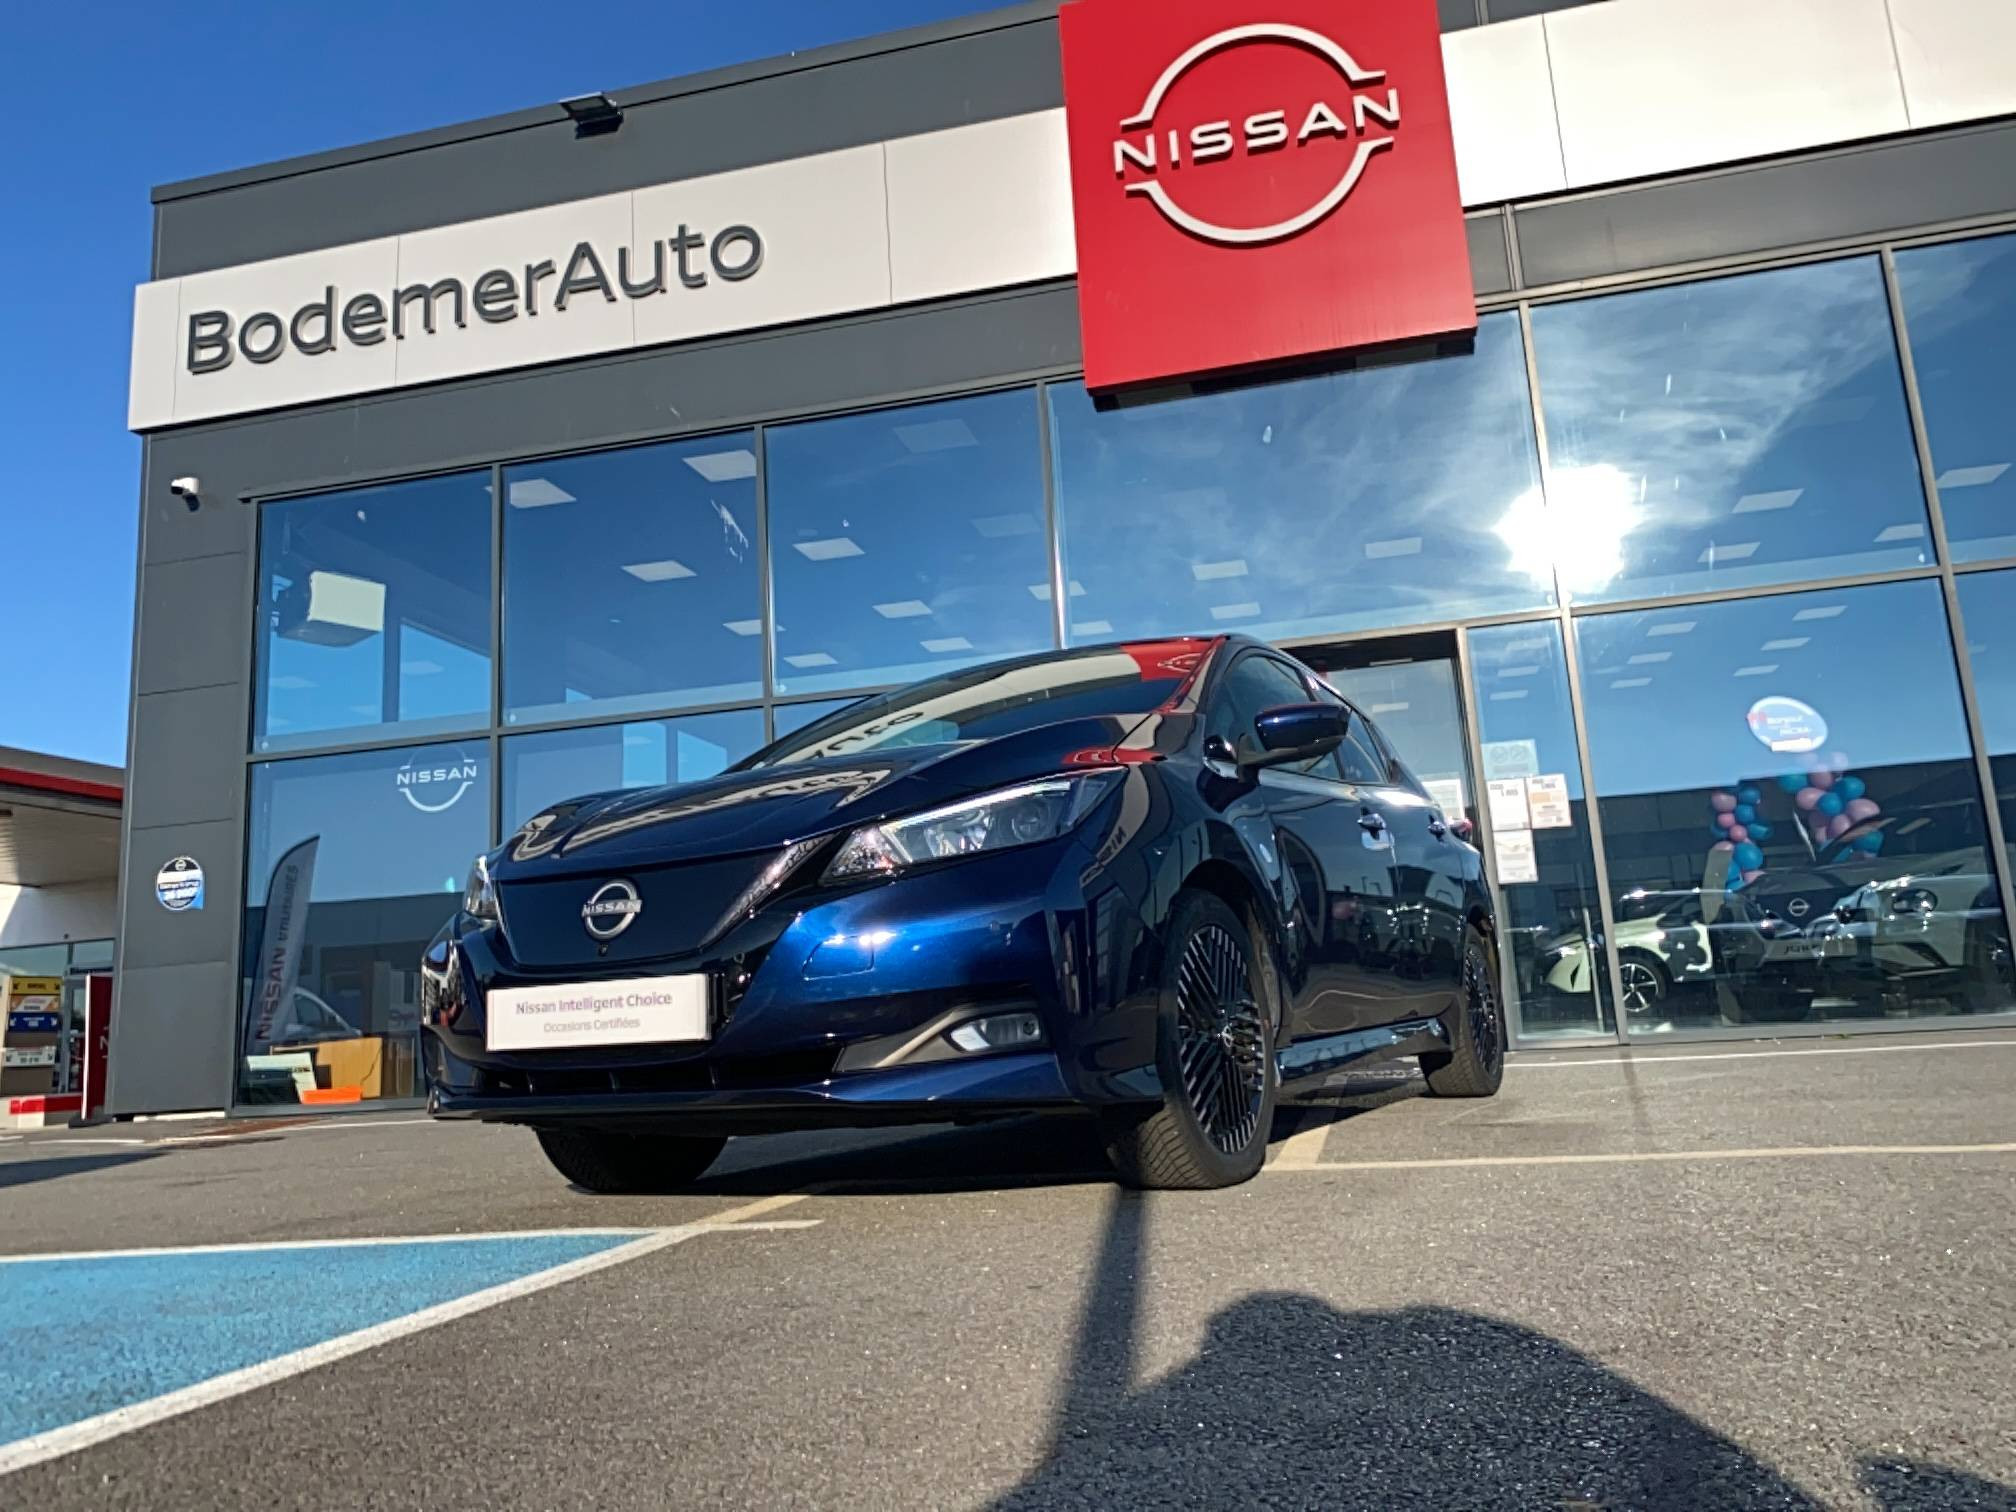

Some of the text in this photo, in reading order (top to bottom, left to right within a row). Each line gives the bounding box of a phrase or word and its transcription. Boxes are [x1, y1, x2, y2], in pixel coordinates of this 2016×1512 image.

[1113, 88, 1401, 178] NISSAN
[186, 223, 765, 375] BodemerAuto
[396, 764, 477, 785] NISSAN
[582, 900, 642, 916] NISSAN
[255, 947, 287, 1041] NISSAN
[515, 991, 673, 1014] Nissan Intelligent Choice
[543, 1019, 592, 1033] Occasions
